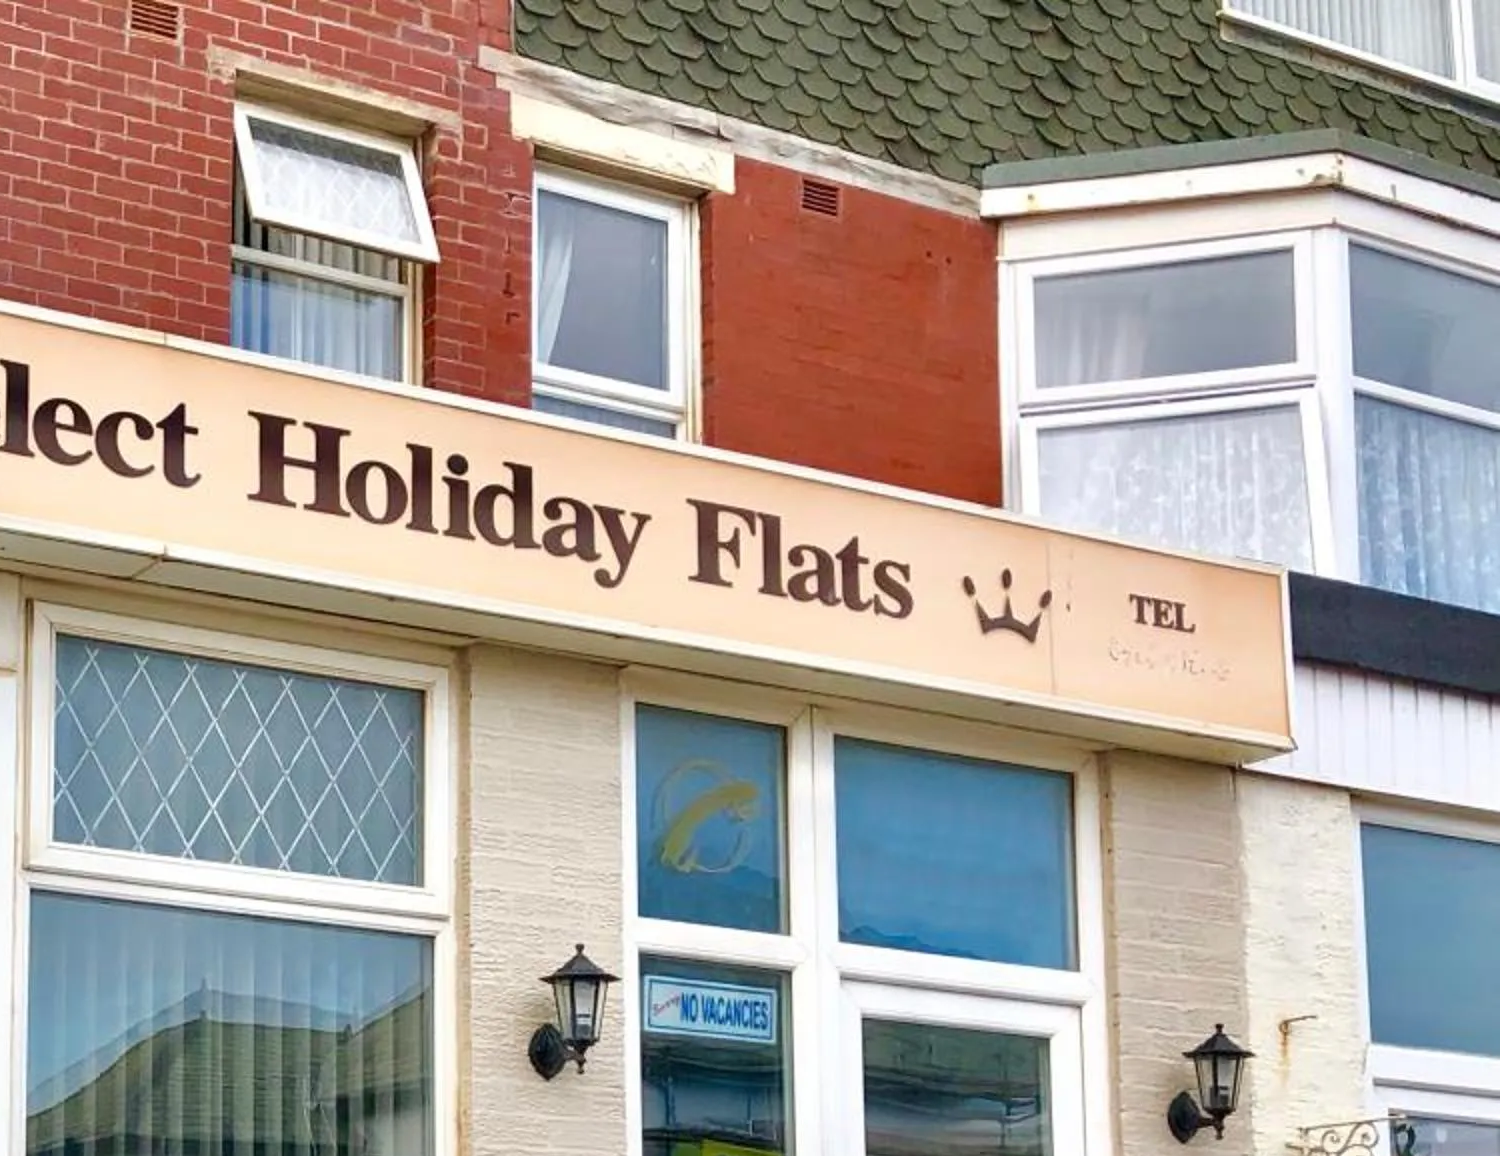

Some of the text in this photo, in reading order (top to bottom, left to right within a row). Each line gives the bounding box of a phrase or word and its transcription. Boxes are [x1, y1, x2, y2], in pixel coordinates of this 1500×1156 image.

[247, 410, 652, 589] Holiday
[686, 497, 914, 619] Flats
[1128, 592, 1197, 635] TEL
[681, 991, 699, 1022] NO
[701, 994, 770, 1031] VACANCIES
